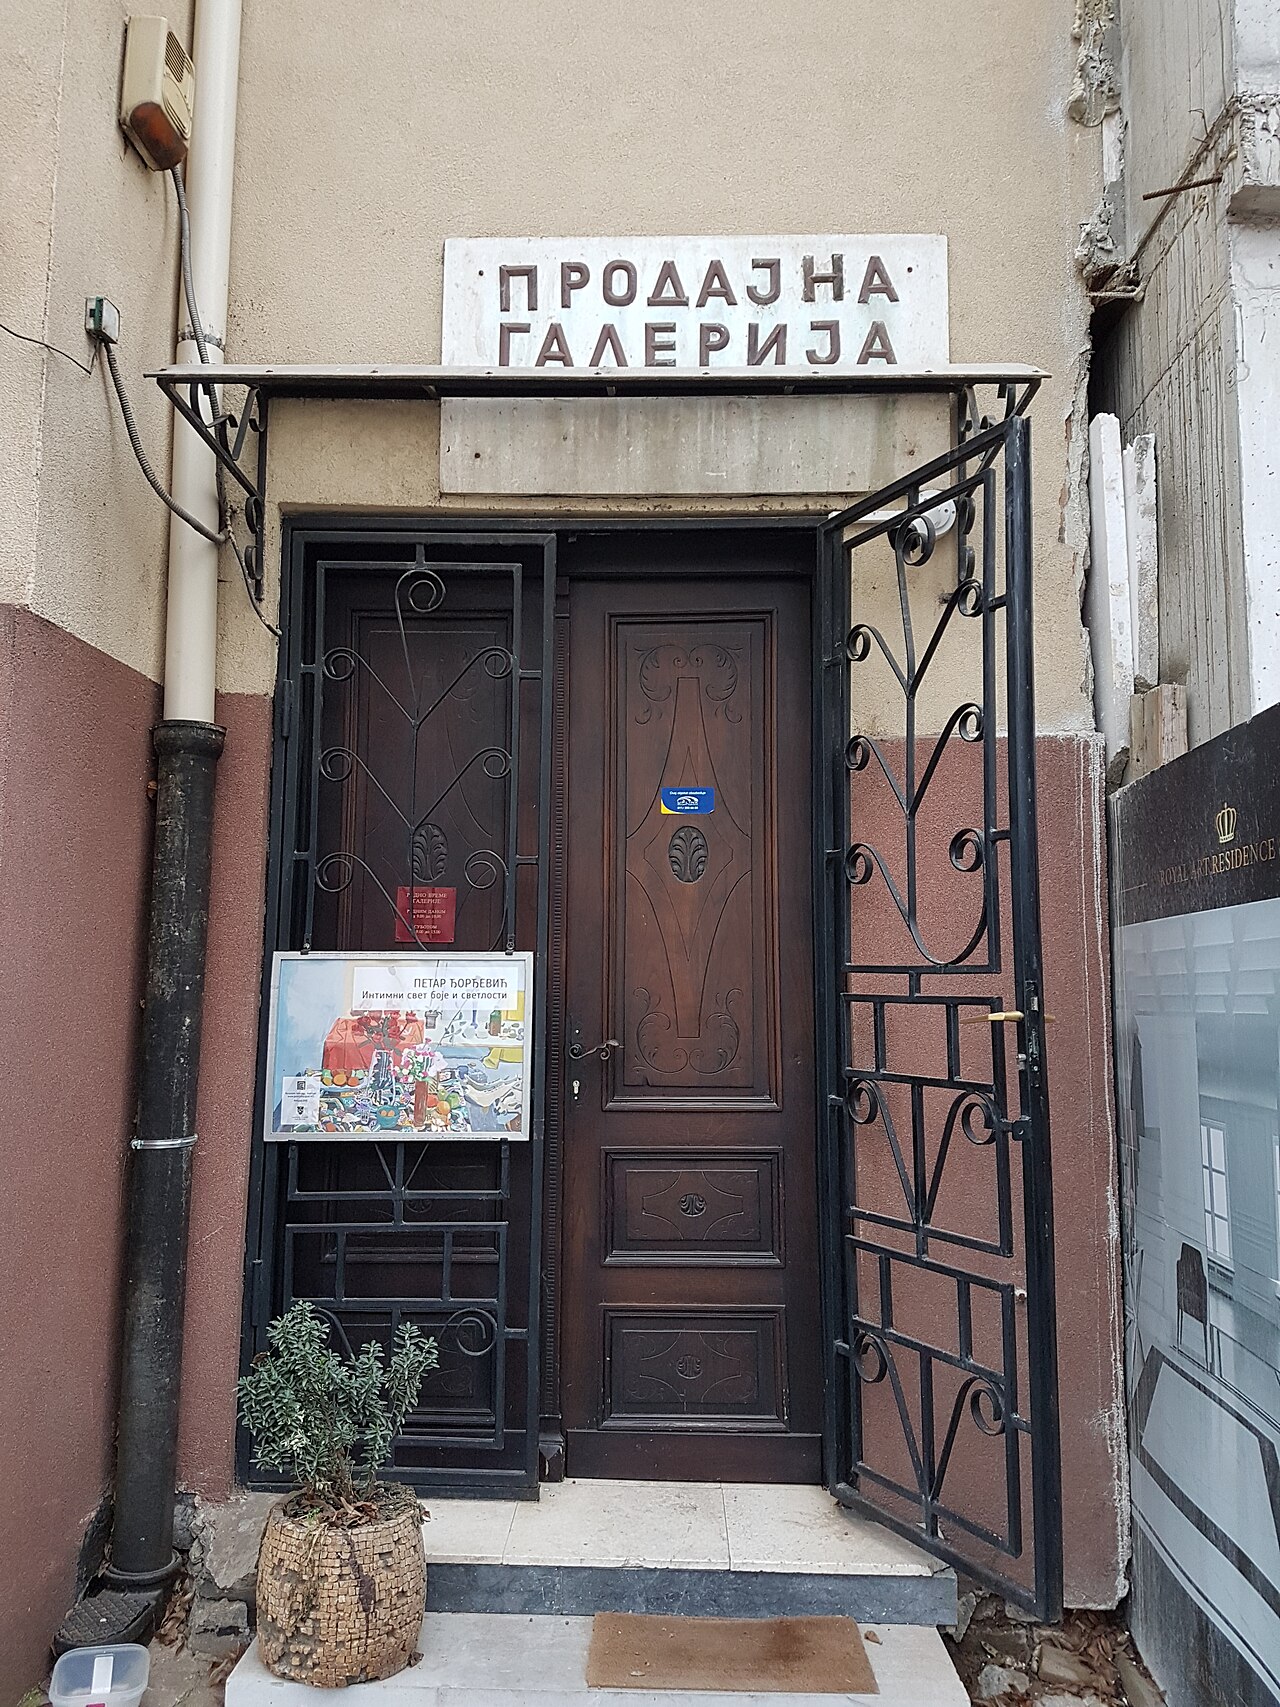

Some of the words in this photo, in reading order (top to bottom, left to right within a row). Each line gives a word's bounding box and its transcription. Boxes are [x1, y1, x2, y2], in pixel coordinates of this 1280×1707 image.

[499, 254, 900, 312] ПРОДАЈНА
[499, 320, 898, 367] ГАЛЕРИЈА
[1159, 863, 1188, 888] ROYAL
[1212, 838, 1276, 874] RESIDENCE
[362, 990, 404, 999] Интимни
[407, 989, 428, 1000] свет
[430, 988, 449, 1001] боје
[452, 990, 458, 999] и
[461, 989, 508, 1000] светлости
[414, 978, 446, 988] ПЕТАР
[450, 978, 508, 989] ЂОРЂЕВИЋ
